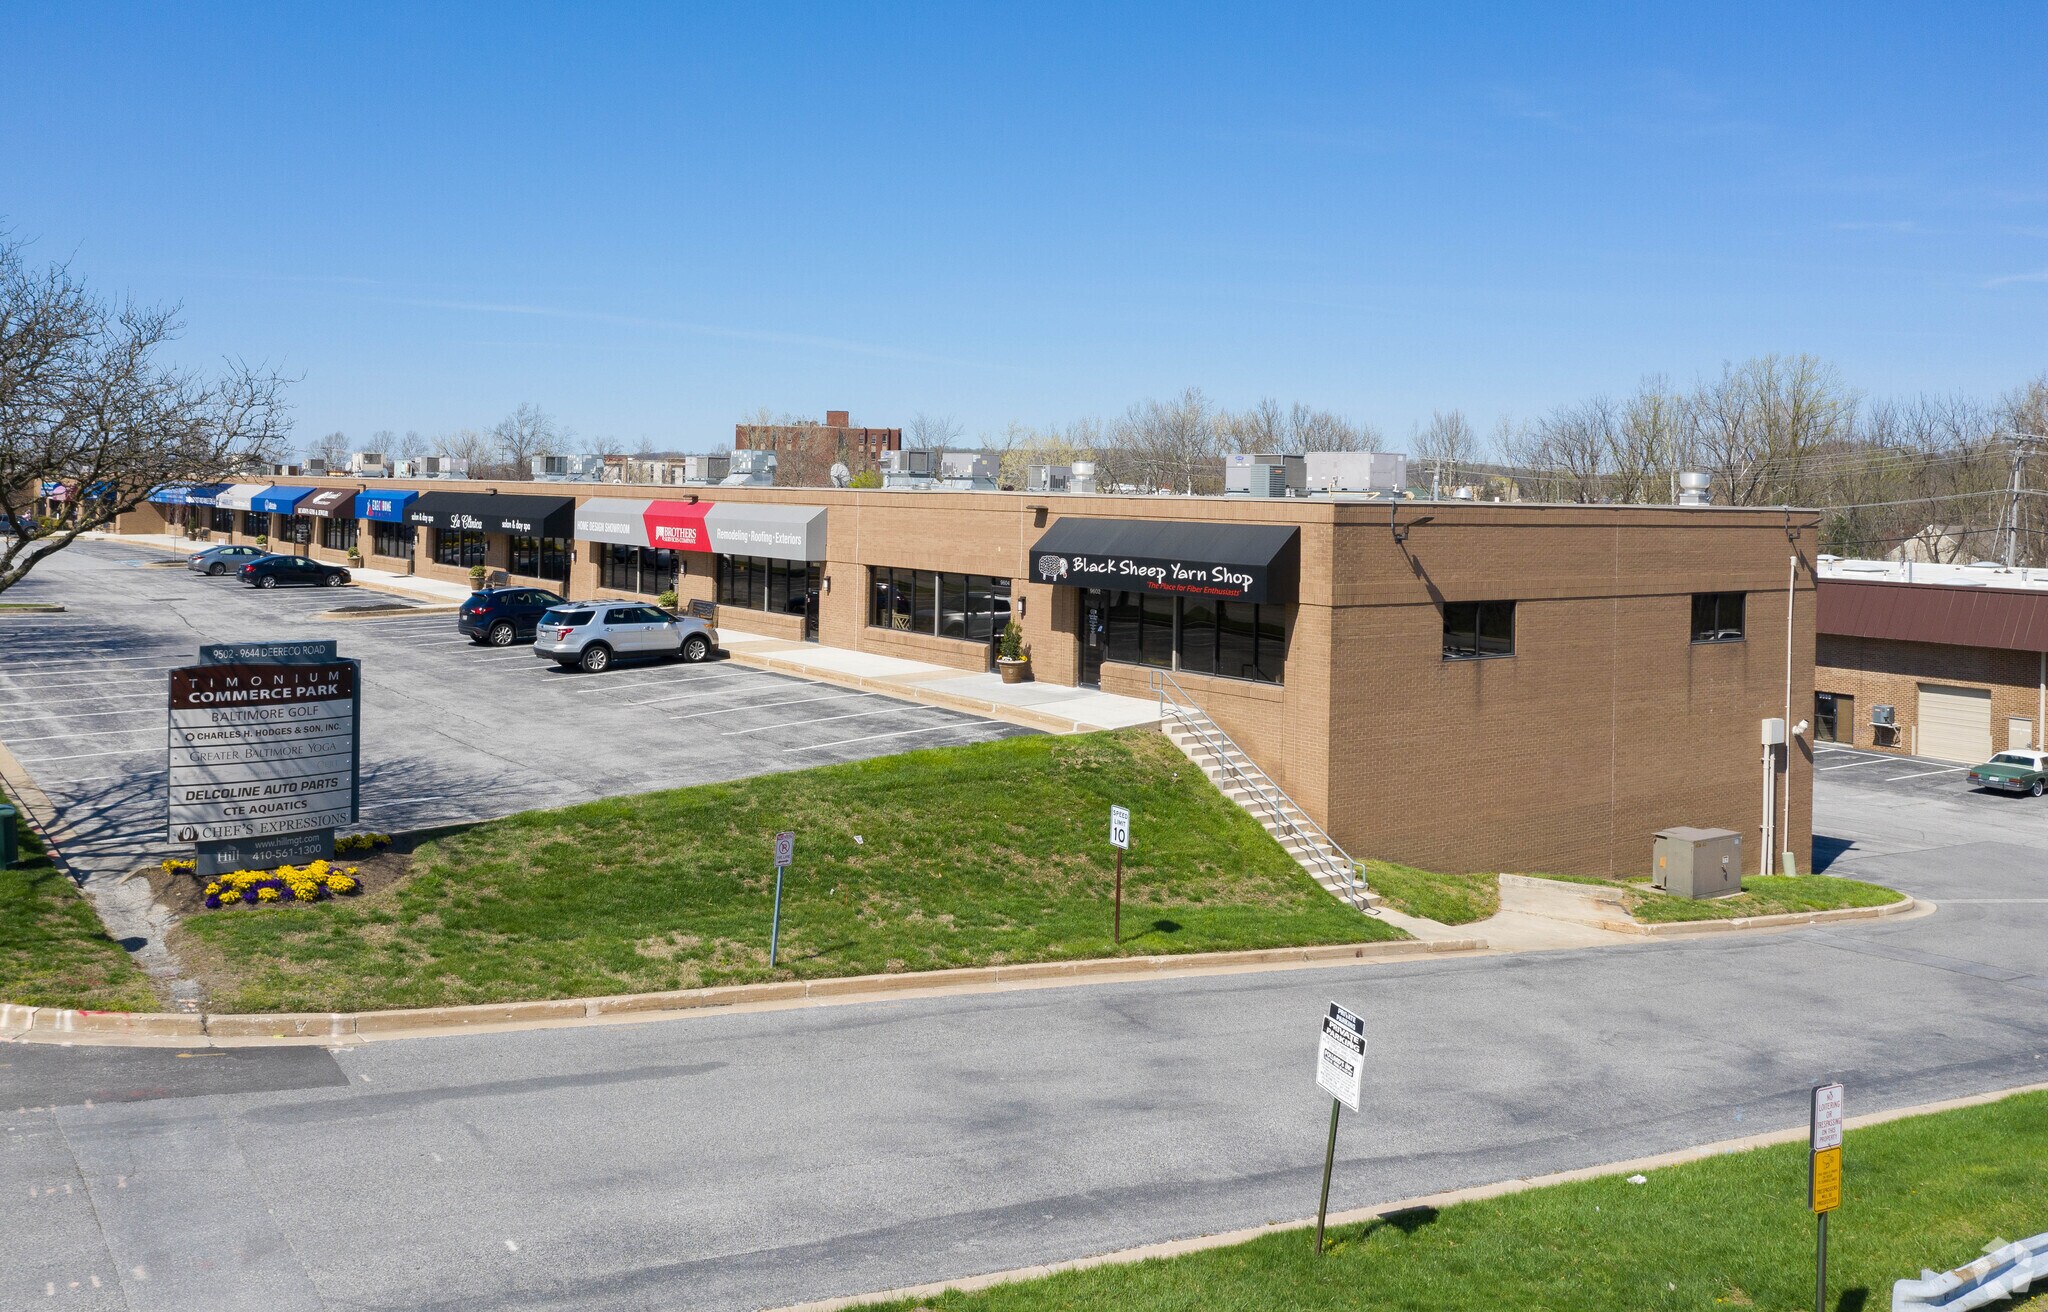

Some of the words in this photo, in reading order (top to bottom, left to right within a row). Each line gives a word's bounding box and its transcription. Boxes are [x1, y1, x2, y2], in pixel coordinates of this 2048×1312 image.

[512, 521, 516, 530] &
[578, 521, 588, 530] HOME
[589, 522, 604, 532] DESIGN
[605, 523, 630, 534] SHOWROOM
[664, 527, 696, 539] BROTHERS
[717, 528, 748, 543] Remodeling
[751, 533, 772, 545] Roofing
[776, 534, 801, 545] Exteriors
[1072, 557, 1117, 574] Black
[1120, 560, 1166, 584] Sheep
[1171, 563, 1207, 580] Yarn
[1212, 566, 1254, 592] Shop
[1160, 583, 1176, 591] Place
[1176, 584, 1186, 592] for
[1186, 585, 1203, 593] Fiber
[213, 650, 234, 659] 9502
[240, 649, 260, 658] 9644
[261, 647, 301, 657] DEERECO
[303, 645, 326, 655] ROAD
[188, 687, 292, 703] COMMERCE
[296, 684, 338, 697] PARK
[212, 708, 284, 722] BALTIMORE
[288, 706, 319, 717] GOLF
[197, 731, 241, 740] CHARLES
[244, 730, 253, 738] H.
[255, 727, 292, 736] HODGES
[294, 726, 301, 734] &
[325, 723, 342, 731] INC.
[308, 742, 337, 753] YOGA
[186, 786, 260, 801] DELCOLINE
[264, 782, 298, 795] AUTO
[301, 778, 339, 791] PARTS
[223, 804, 245, 816] CTE
[249, 800, 308, 814] AQUATICS
[1113, 810, 1128, 819] SPEED
[260, 812, 347, 834] EXPRESSIONS
[255, 834, 319, 849] www.hillmgt.com
[1114, 827, 1125, 842] 10
[217, 850, 239, 862] Hill
[253, 844, 322, 860] 410-561-1300
[1326, 1027, 1360, 1053] PARKING
[1329, 1021, 1360, 1044] PRIVATE
